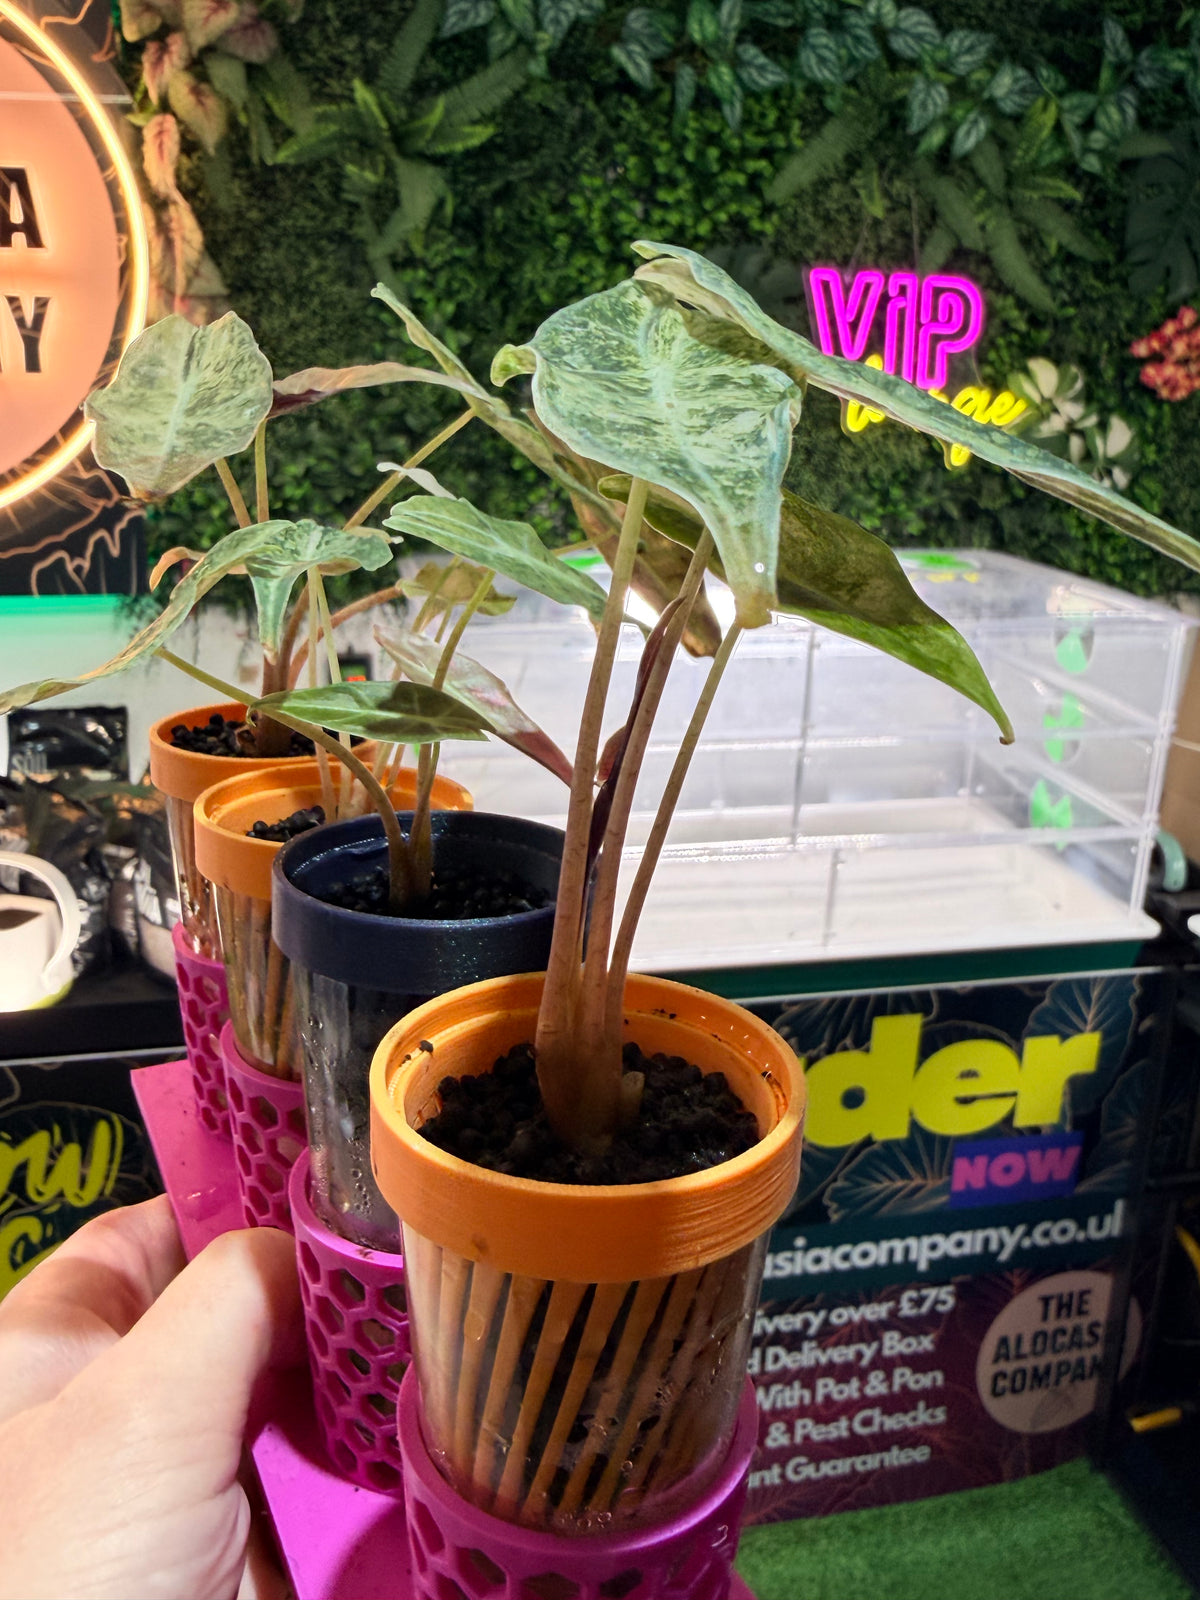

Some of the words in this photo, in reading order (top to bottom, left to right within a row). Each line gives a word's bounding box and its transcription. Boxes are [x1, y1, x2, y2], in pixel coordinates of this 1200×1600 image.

[803, 1013, 1101, 1148] der
[950, 1146, 1081, 1192] NOW
[753, 1308, 828, 1337] ivery
[829, 1300, 895, 1326] over
[898, 1285, 955, 1317] £75
[1039, 1290, 1092, 1322] THE
[764, 1339, 880, 1371] Delivery
[881, 1330, 936, 1357] Box
[815, 1375, 860, 1404] Pot
[863, 1369, 889, 1397] &
[892, 1366, 945, 1392] Pon
[764, 1421, 790, 1449] &
[794, 1412, 850, 1445] Pest
[852, 1400, 948, 1436] Checks
[785, 1444, 931, 1483] Guarantee
